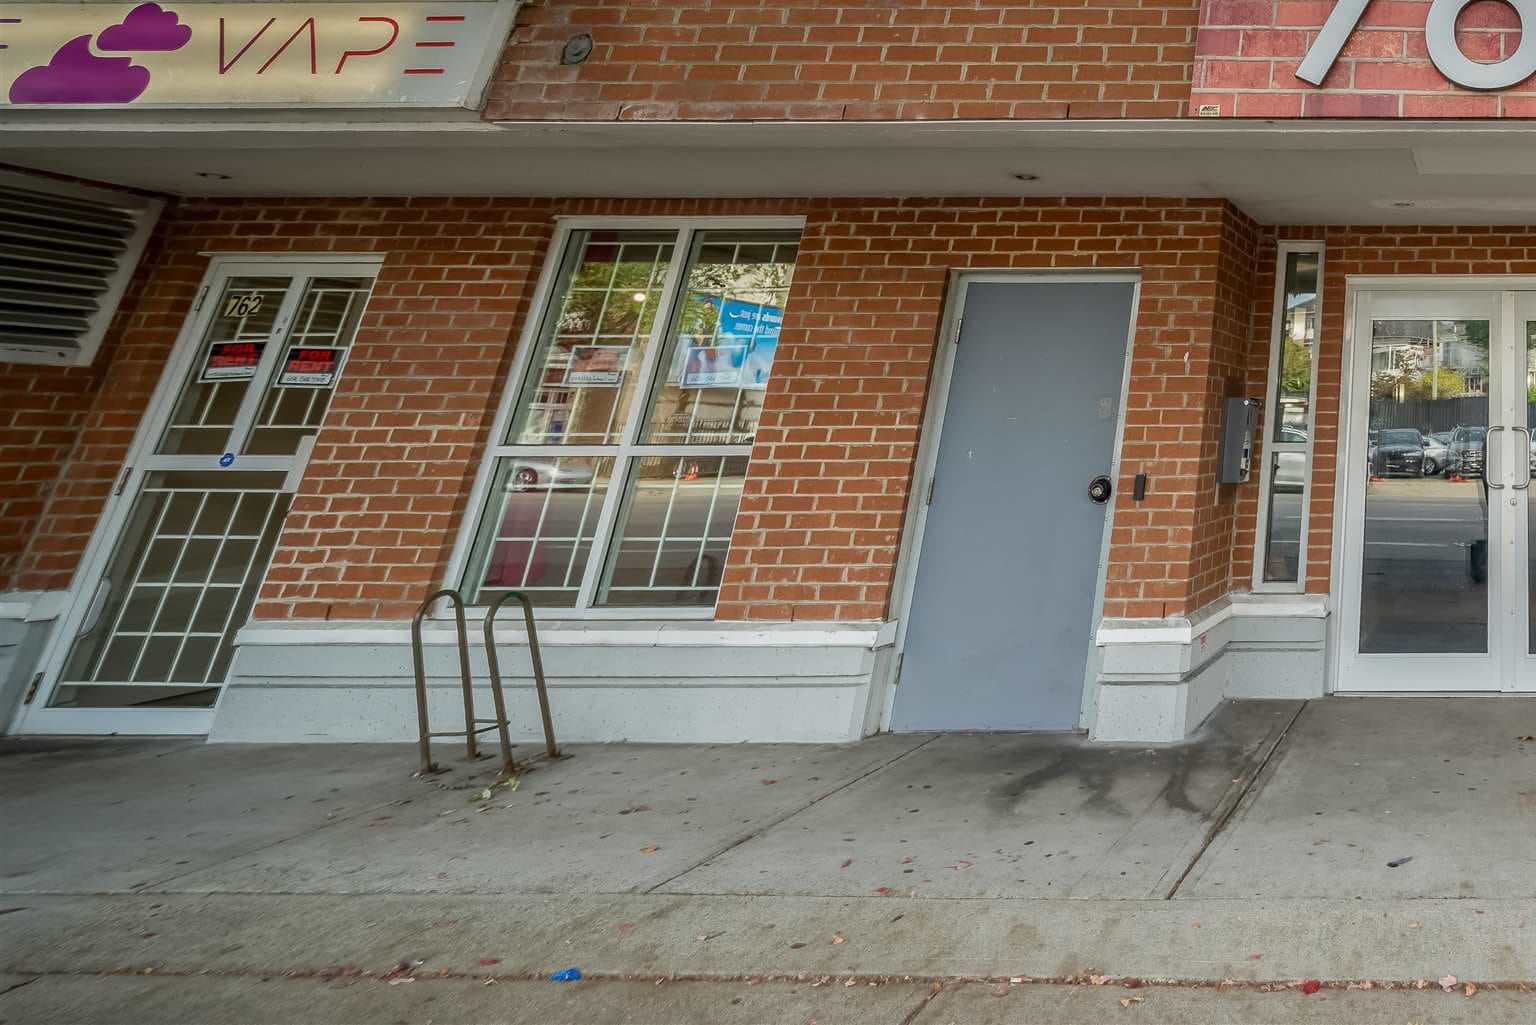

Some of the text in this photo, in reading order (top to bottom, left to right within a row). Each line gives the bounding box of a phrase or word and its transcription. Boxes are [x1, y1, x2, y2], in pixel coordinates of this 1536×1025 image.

[219, 15, 465, 75] VAPE
[227, 295, 262, 316] 762
[222, 343, 256, 354] FOR
[299, 350, 332, 361] FOR
[287, 360, 335, 372] RENT
